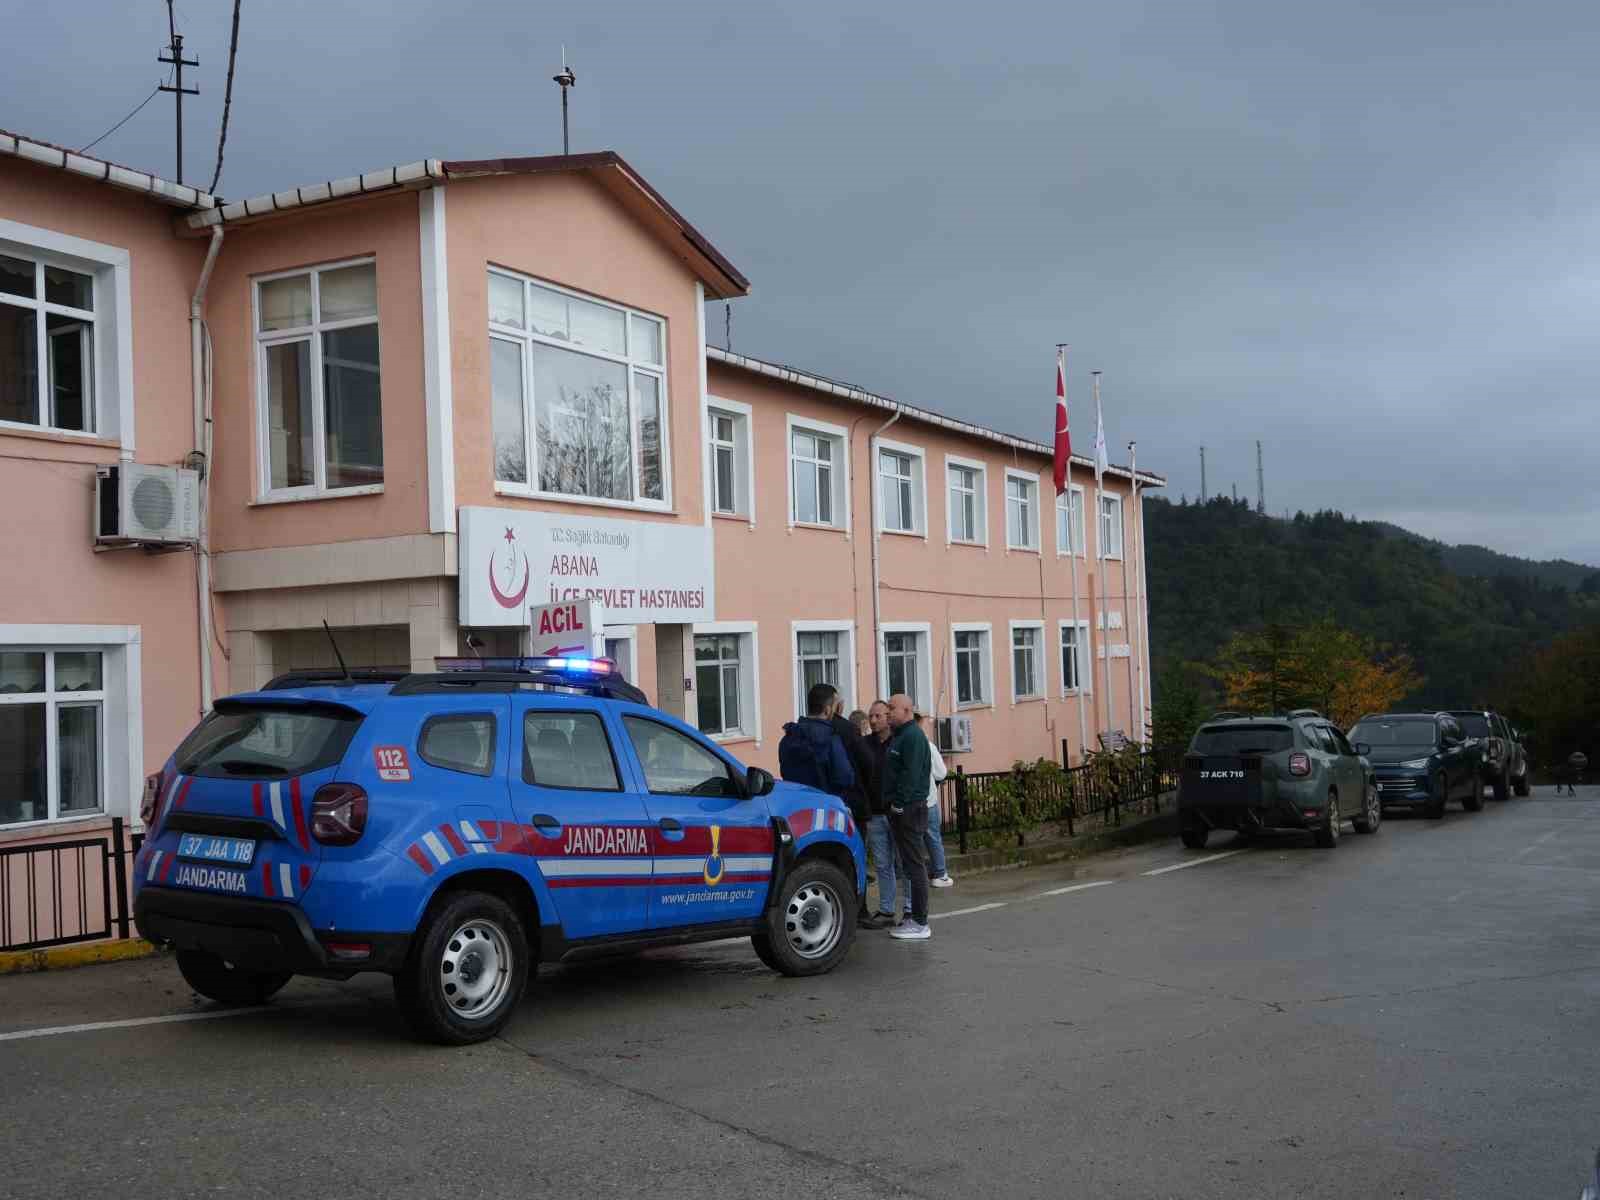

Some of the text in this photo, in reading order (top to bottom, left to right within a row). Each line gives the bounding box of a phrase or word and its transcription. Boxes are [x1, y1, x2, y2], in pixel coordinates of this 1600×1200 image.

[550, 554, 599, 576] ABANA
[639, 586, 704, 609] HASTANESİ
[378, 749, 404, 767] 112
[1200, 770, 1209, 778] 37
[185, 836, 253, 862] 37 JAA 118
[564, 827, 648, 854] JANDARMA
[176, 866, 246, 893] JANDARMA
[661, 888, 754, 905] www.jandarma.gov.tr
